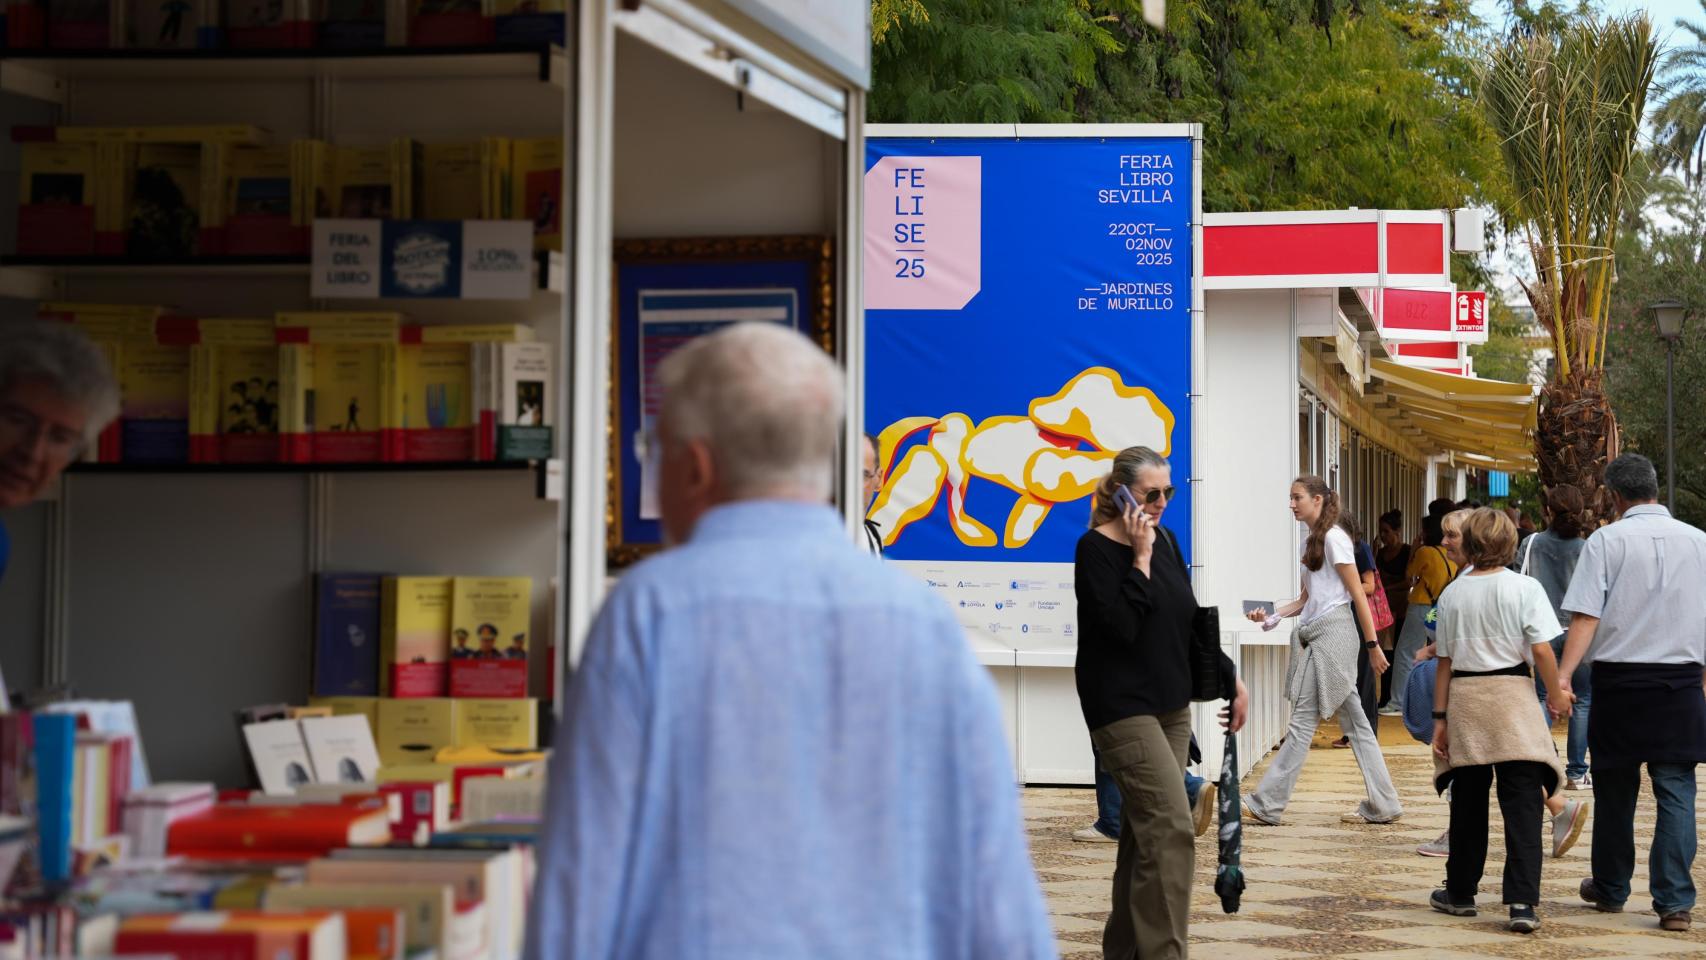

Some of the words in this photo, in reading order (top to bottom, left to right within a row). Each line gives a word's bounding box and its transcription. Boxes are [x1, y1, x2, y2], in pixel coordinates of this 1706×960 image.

[1120, 154, 1173, 169] FERIA
[894, 168, 926, 189] FE
[1120, 171, 1174, 186] LIBRO
[1098, 189, 1173, 204] SEVILLA
[895, 195, 925, 216] LI
[329, 233, 371, 247] FERIA
[894, 222, 926, 244] SE
[1125, 237, 1173, 251] 02NOV
[332, 252, 361, 266] DEL
[476, 247, 518, 263] 10%
[1136, 252, 1173, 266] 2025
[895, 257, 926, 279] 25
[327, 271, 370, 285] LIBRO
[1078, 297, 1098, 310] DE
[1107, 297, 1173, 310] MURILLO
